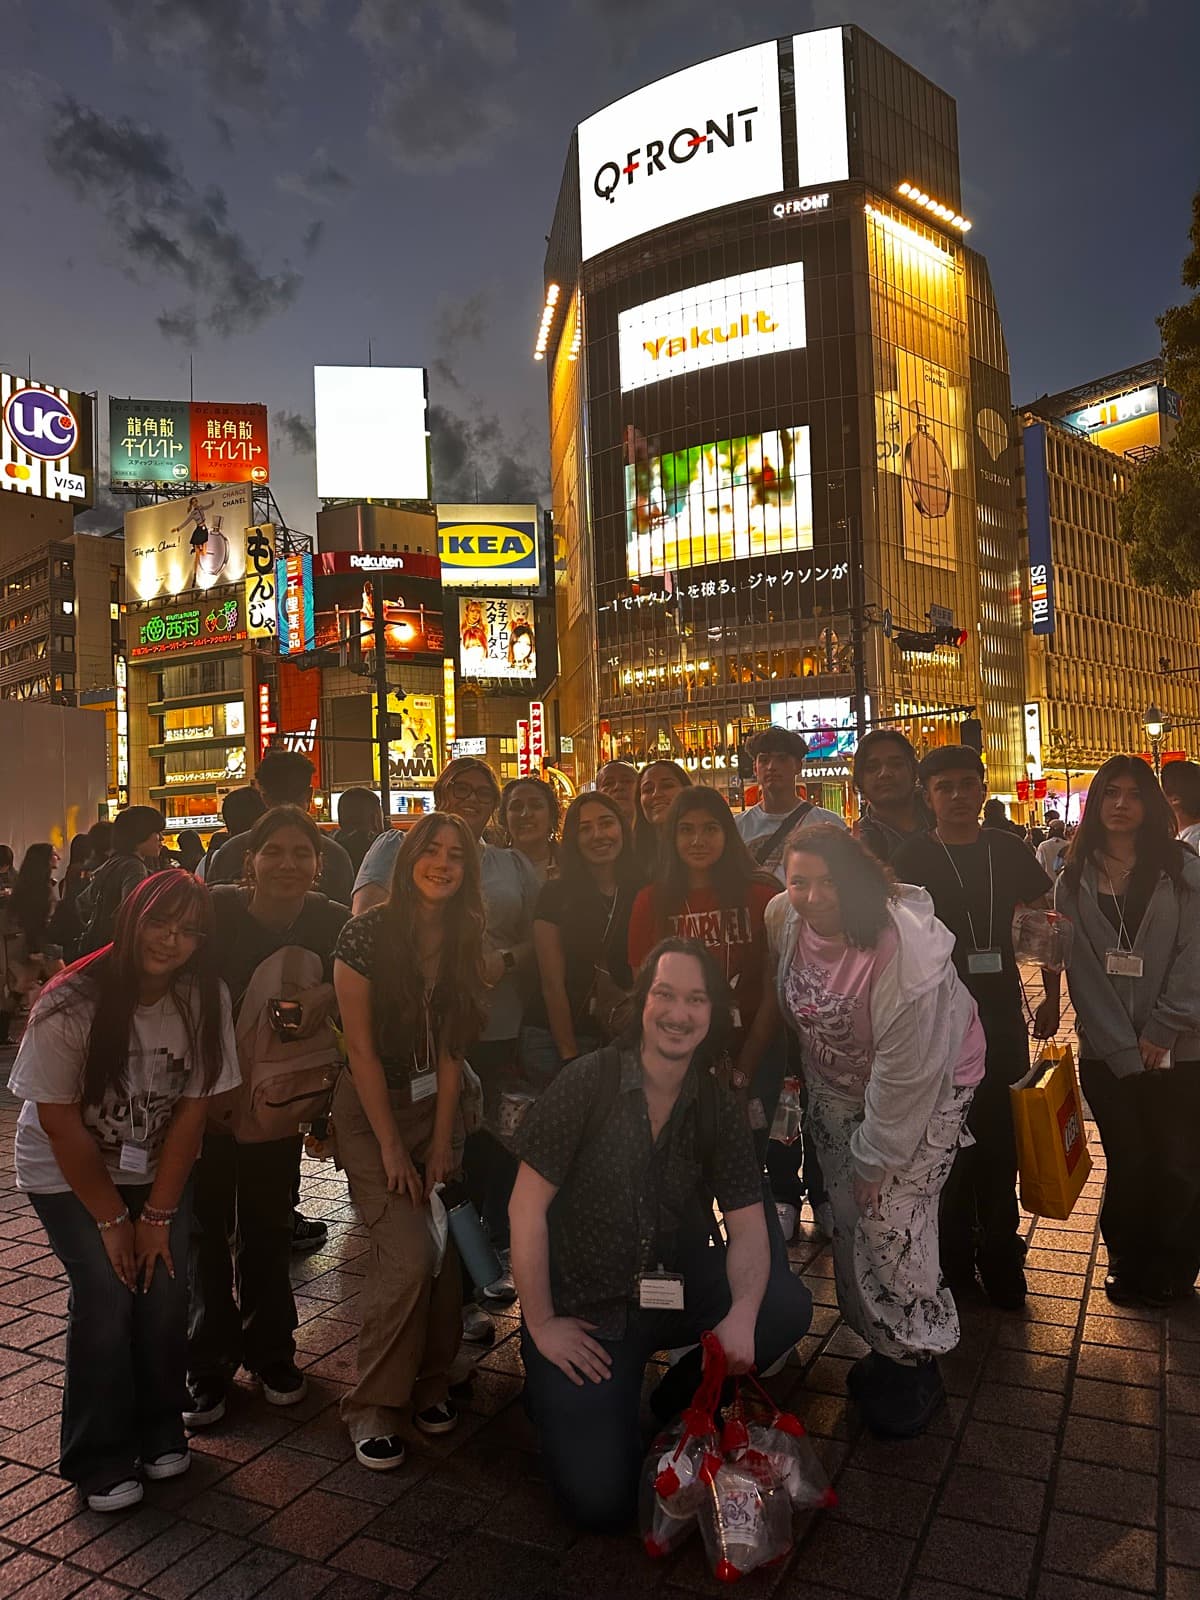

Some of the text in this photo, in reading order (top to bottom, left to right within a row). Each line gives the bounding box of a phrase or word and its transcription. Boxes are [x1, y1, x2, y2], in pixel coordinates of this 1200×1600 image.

[594, 106, 758, 204] QFRONT
[773, 193, 830, 218] QFRONT
[643, 311, 779, 360] Yakult
[127, 417, 174, 437] 龍角散
[207, 419, 253, 440] 龍角散
[54, 476, 84, 491] VISA
[222, 497, 248, 508] CHANEL
[438, 536, 527, 554] IKEA
[350, 554, 404, 571] Rakuten
[247, 528, 276, 634] もんじゃ
[1030, 564, 1049, 625] SEIBU
[801, 766, 850, 778] TSUTAYA
